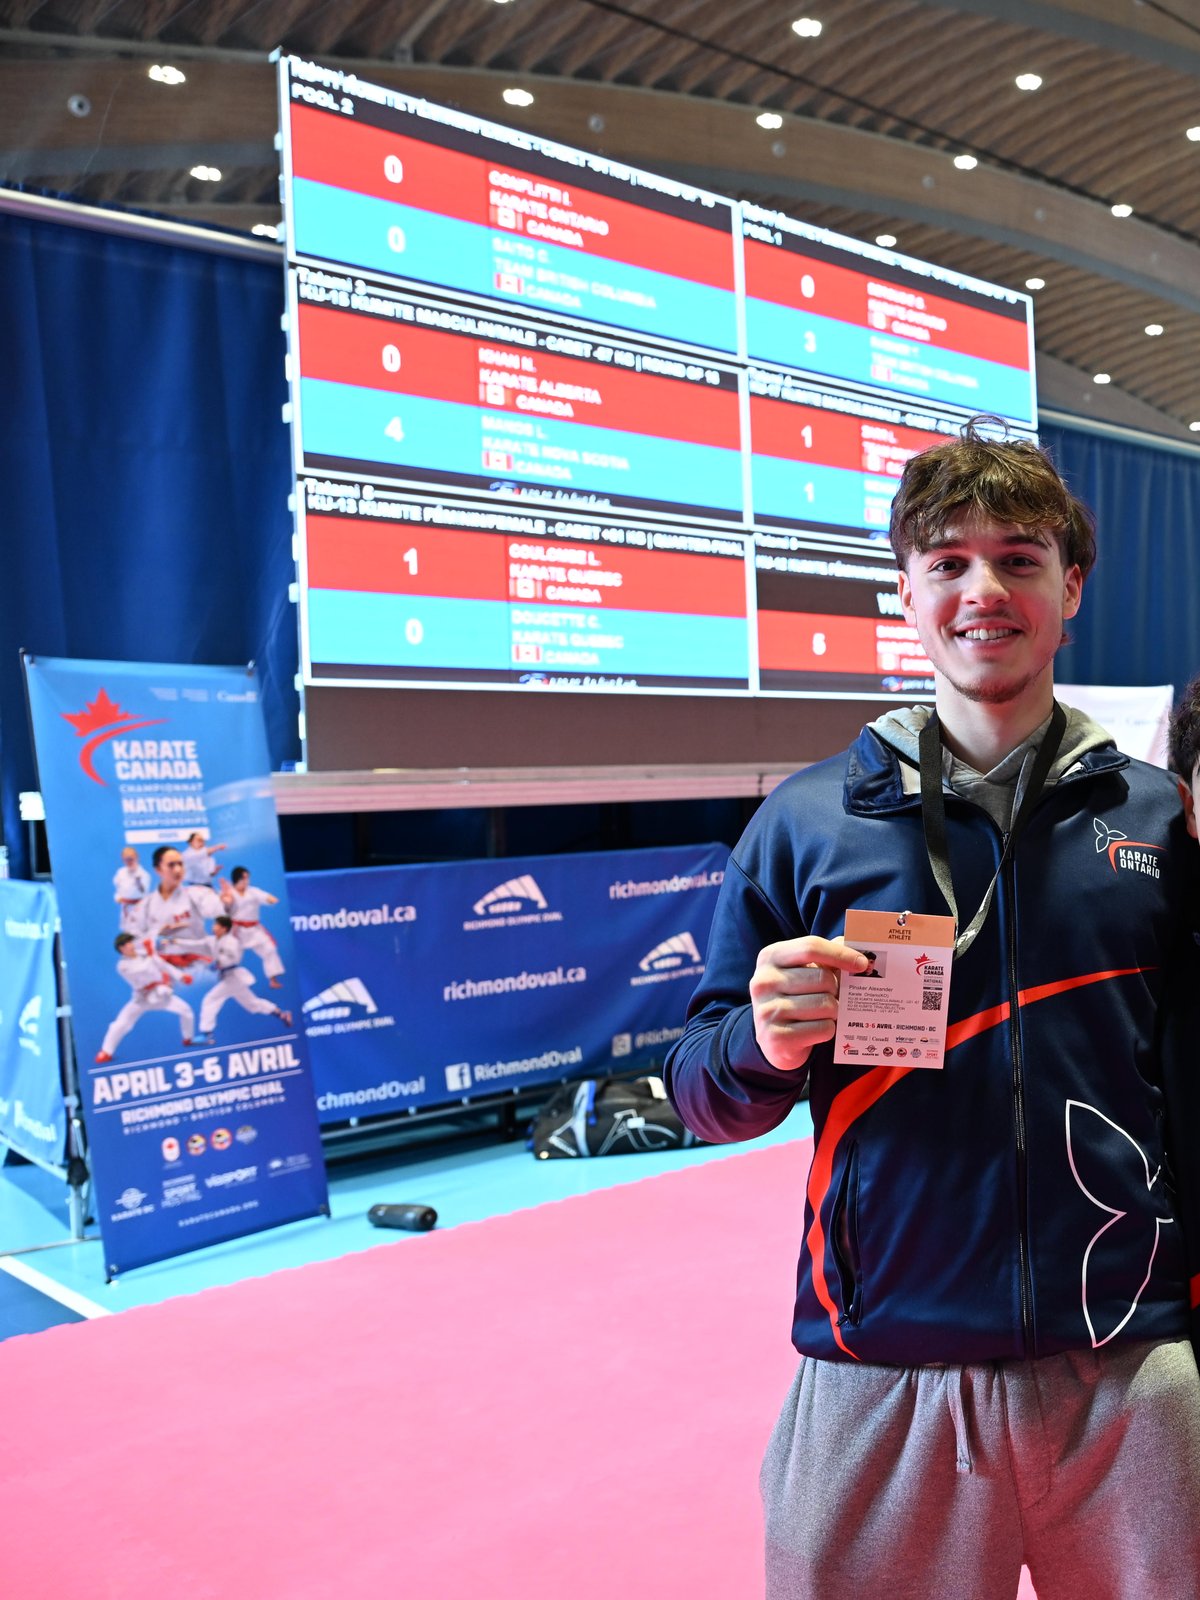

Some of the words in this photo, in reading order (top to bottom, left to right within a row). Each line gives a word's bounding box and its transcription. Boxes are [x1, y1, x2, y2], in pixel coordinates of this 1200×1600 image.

[383, 154, 404, 184] 0
[489, 190, 548, 219] KARATE
[387, 226, 405, 253] 0
[296, 266, 352, 292] Tatami
[801, 275, 815, 298] 0
[382, 344, 401, 372] 0
[480, 368, 538, 393] KARATE
[384, 416, 405, 442] 4
[801, 425, 812, 448] 1
[304, 478, 360, 499] Tatami
[805, 483, 814, 501] 1
[403, 547, 418, 576] 1
[509, 563, 567, 583] KARATE
[405, 618, 423, 646] 0
[112, 740, 197, 760] KARATE
[115, 761, 202, 780] CANADA
[121, 796, 206, 814] NATIONAL
[1119, 848, 1158, 867] KARATE
[1120, 858, 1160, 879] ONTARIO
[443, 966, 586, 1001] richmondoval.ca
[93, 1066, 172, 1105] APRIL
[174, 1056, 222, 1089] 3-6
[228, 1044, 300, 1079] AVRIL
[474, 1047, 583, 1081] RichmondOval
[121, 1097, 194, 1126] RICHMOND
[194, 1086, 252, 1110] OLYMPIC
[251, 1080, 285, 1100] OVAL
